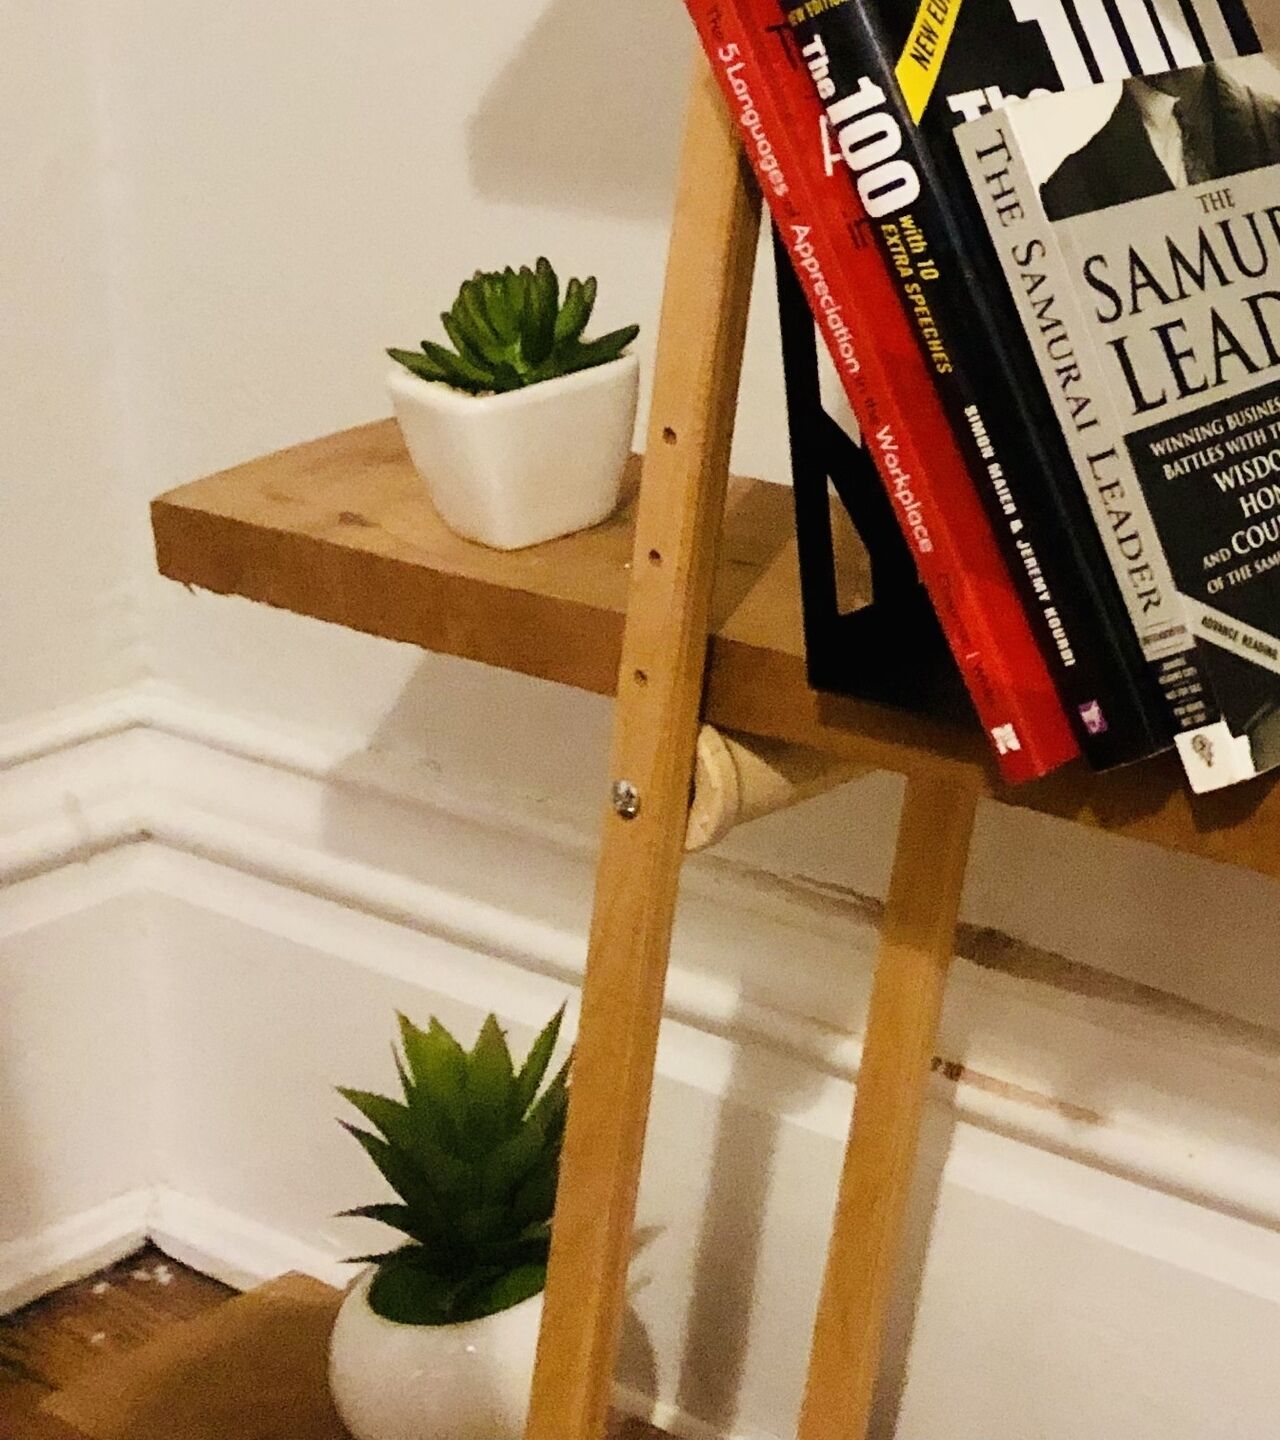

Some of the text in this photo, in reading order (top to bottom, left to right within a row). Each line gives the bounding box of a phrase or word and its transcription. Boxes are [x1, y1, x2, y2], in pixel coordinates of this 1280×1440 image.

[718, 43, 741, 61] 5
[910, 19, 940, 71] NEW
[727, 62, 789, 198] Languages
[802, 33, 836, 100] The
[826, 76, 921, 219] 100
[1195, 188, 1236, 214] THE
[898, 215, 940, 281] with 10
[790, 224, 861, 374] Appreciation
[881, 224, 953, 375] EXTRA SPEECHES
[975, 128, 1024, 228] THE
[1011, 239, 1099, 432] SAMURAI
[1086, 446, 1163, 614] LEADER
[1149, 419, 1225, 457] WINNING
[1162, 443, 1225, 481] BATTLES
[1225, 428, 1269, 455] WITH
[876, 425, 934, 554] Workplace
[964, 404, 996, 460] SIMON
[987, 462, 1017, 516] MAIER
[1016, 539, 1051, 602] JEREMY
[1202, 548, 1232, 570] AND
[1206, 577, 1225, 594] OF
[1226, 563, 1253, 586] THE
[1242, 634, 1278, 661] READING
